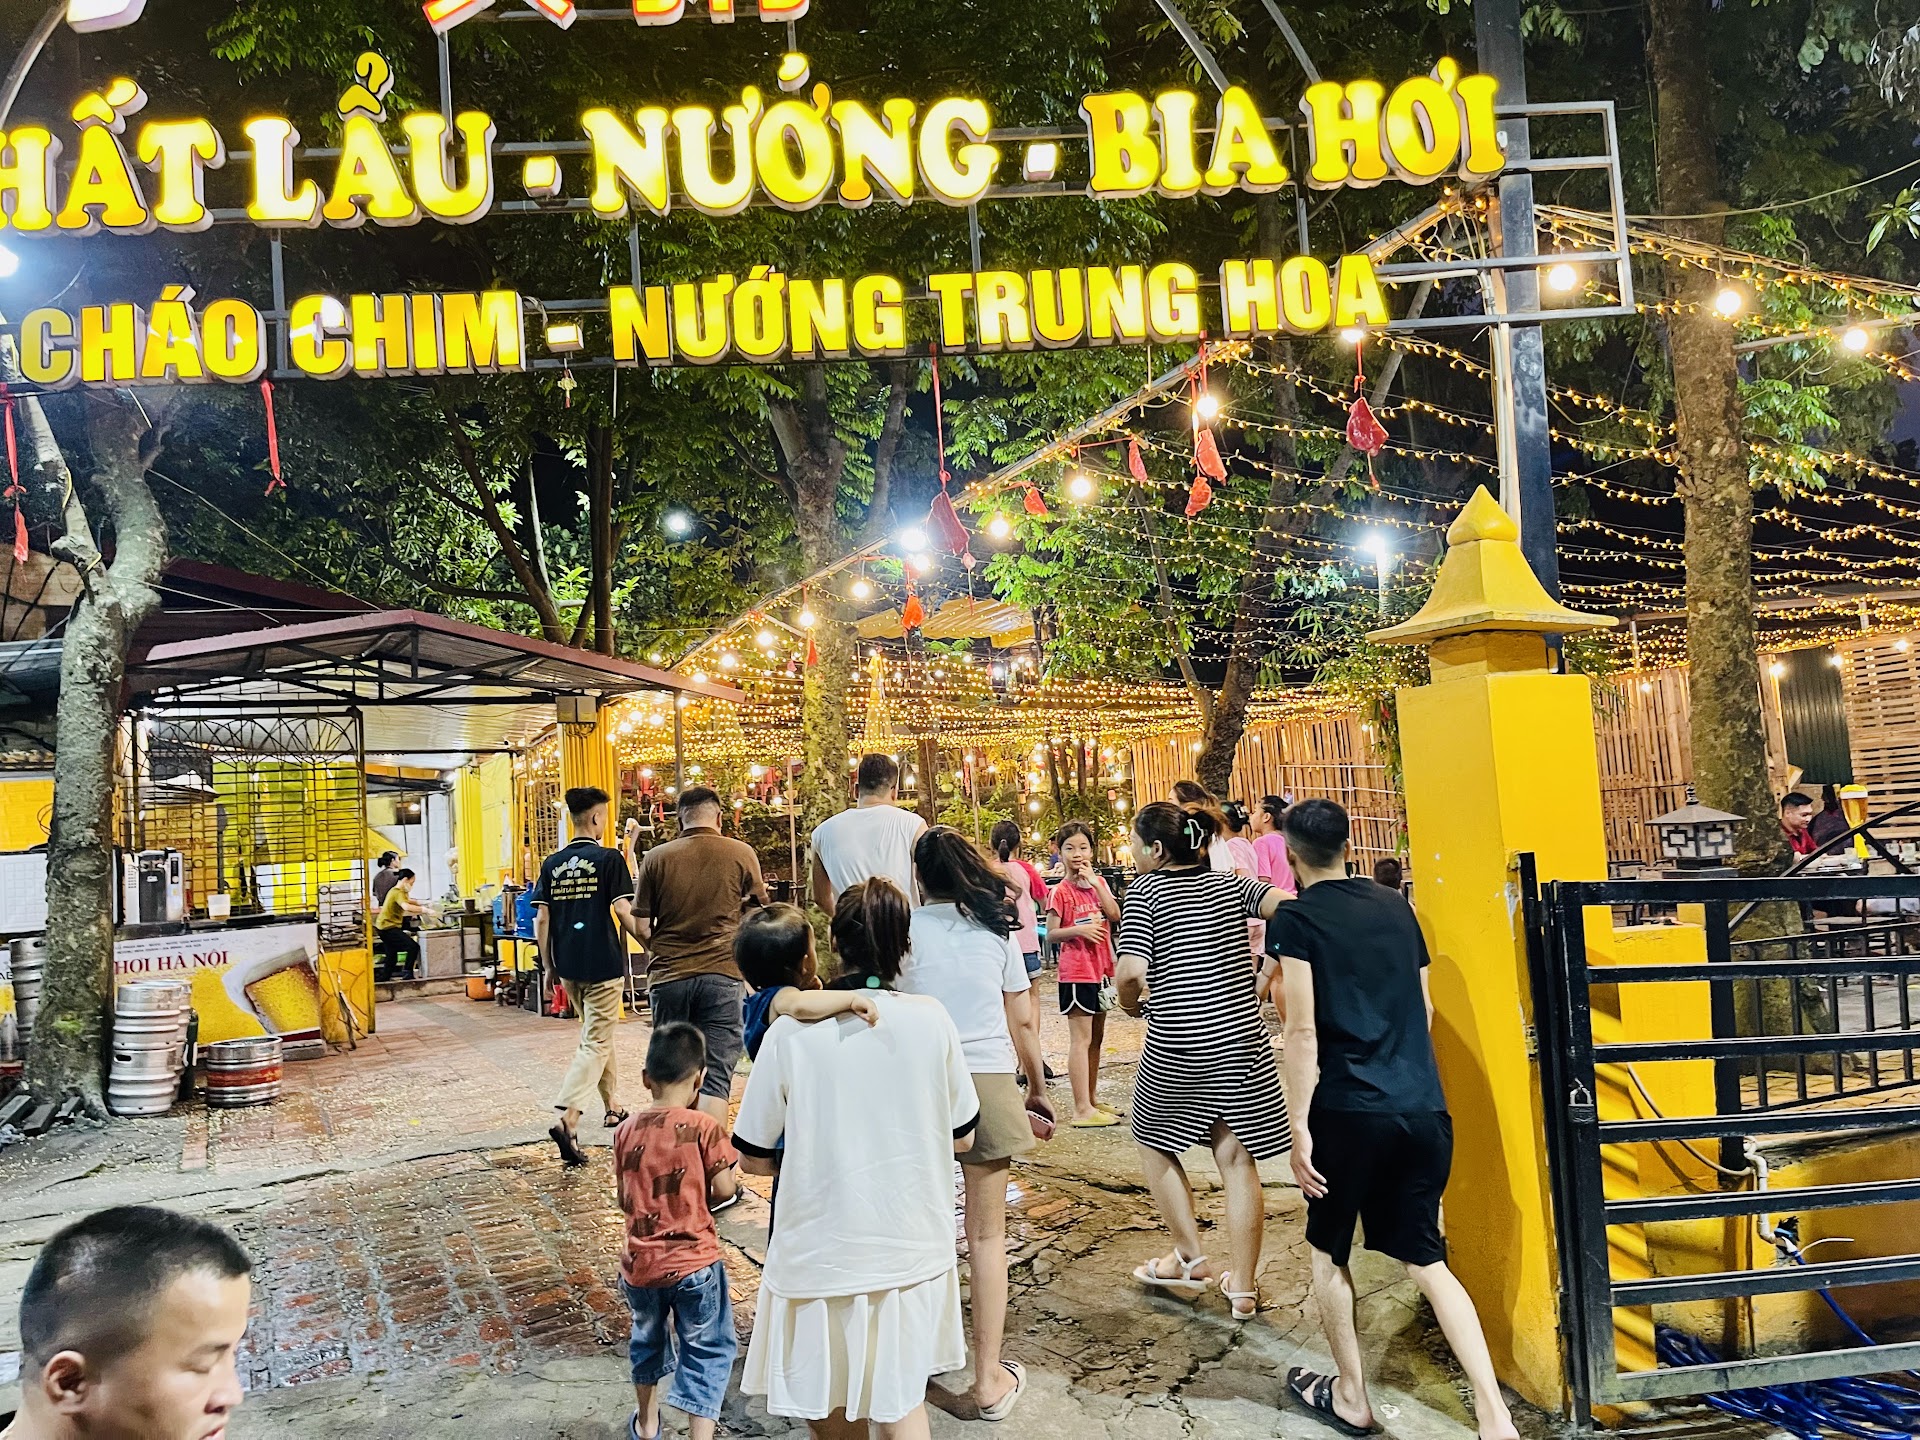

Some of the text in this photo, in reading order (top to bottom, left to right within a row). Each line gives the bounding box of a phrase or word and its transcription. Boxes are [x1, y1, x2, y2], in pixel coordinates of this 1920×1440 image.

[245, 52, 496, 226] LẨU
[582, 51, 1000, 218] NƯỚNG
[1080, 85, 1289, 198] BIA
[1302, 55, 1506, 188] HƠI
[20, 284, 266, 388] CHÁO
[290, 290, 525, 380] CHIM
[609, 265, 906, 367] NƯỚNG
[928, 260, 1201, 348] TRUNG
[1220, 252, 1390, 337] HOA
[157, 951, 187, 971] HÀ
[193, 948, 229, 969] NỘI
